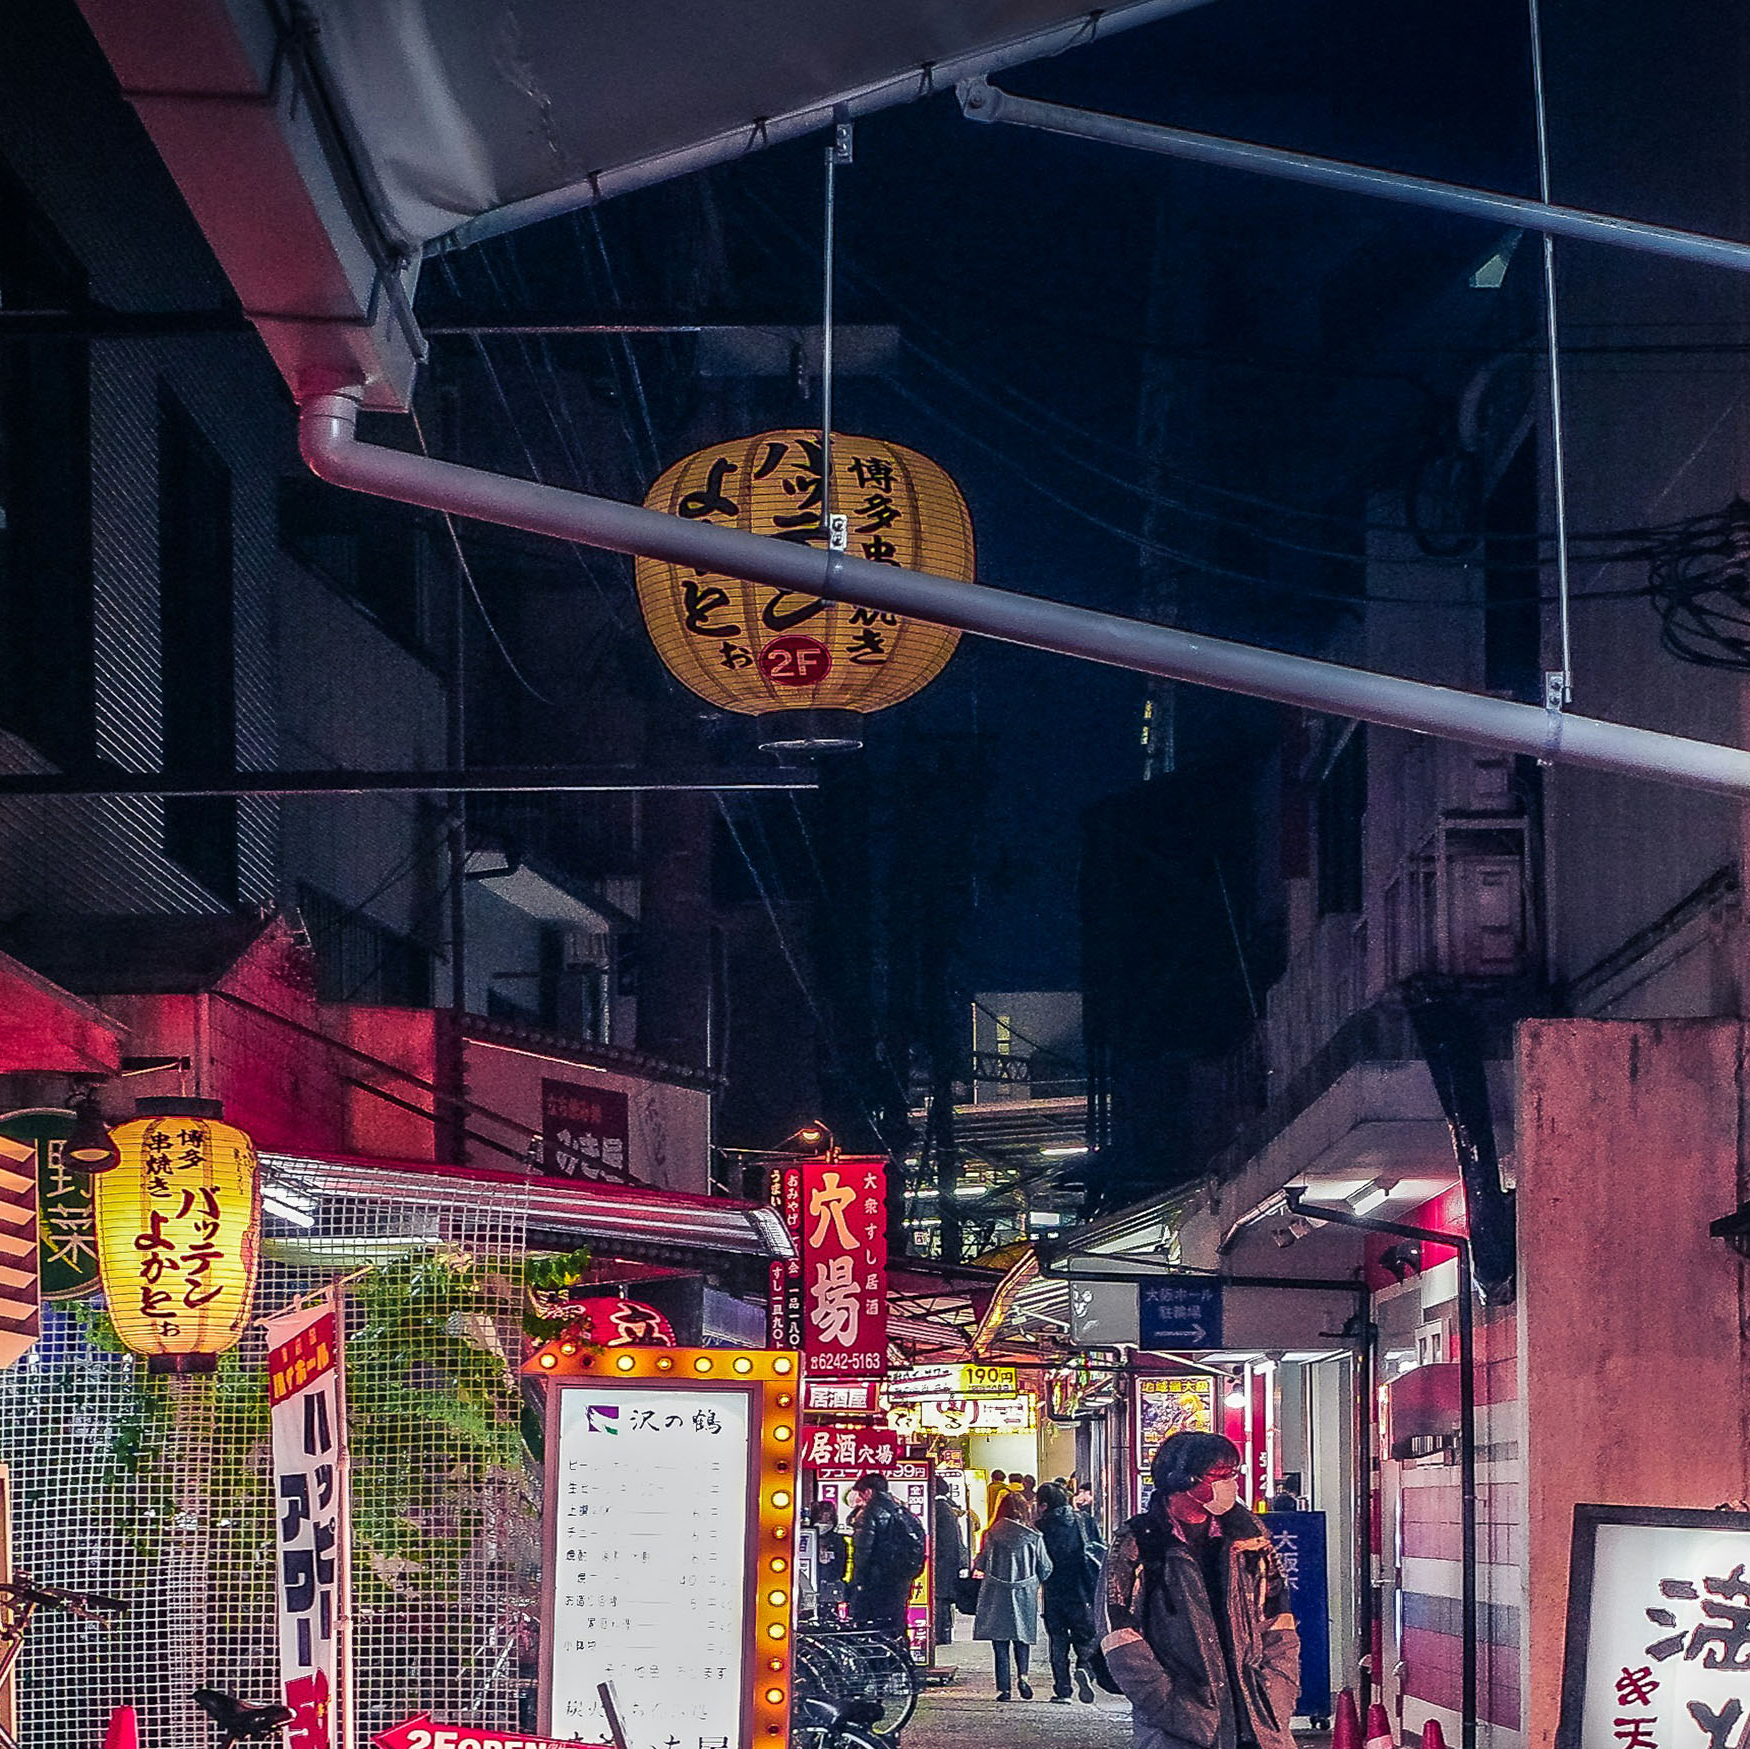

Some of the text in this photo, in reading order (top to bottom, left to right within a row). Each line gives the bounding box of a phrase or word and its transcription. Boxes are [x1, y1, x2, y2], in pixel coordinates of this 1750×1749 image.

[770, 649, 821, 677] 2F
[146, 1131, 173, 1198] 串焼き
[176, 1128, 206, 1170] 博多
[46, 1139, 97, 1264] 野菜
[176, 1187, 223, 1309] バッテン
[809, 1172, 861, 1347] 穴場
[864, 1172, 879, 1316] 大衆すし居酒
[818, 1353, 881, 1370] 6242-5163
[966, 1367, 1014, 1385] 190円
[629, 1408, 724, 1435] 沢の鶴
[809, 1387, 868, 1409] 居酒屋
[857, 1445, 894, 1465] 穴場
[303, 1390, 337, 1640] ハッピー
[279, 1472, 316, 1667] アワー
